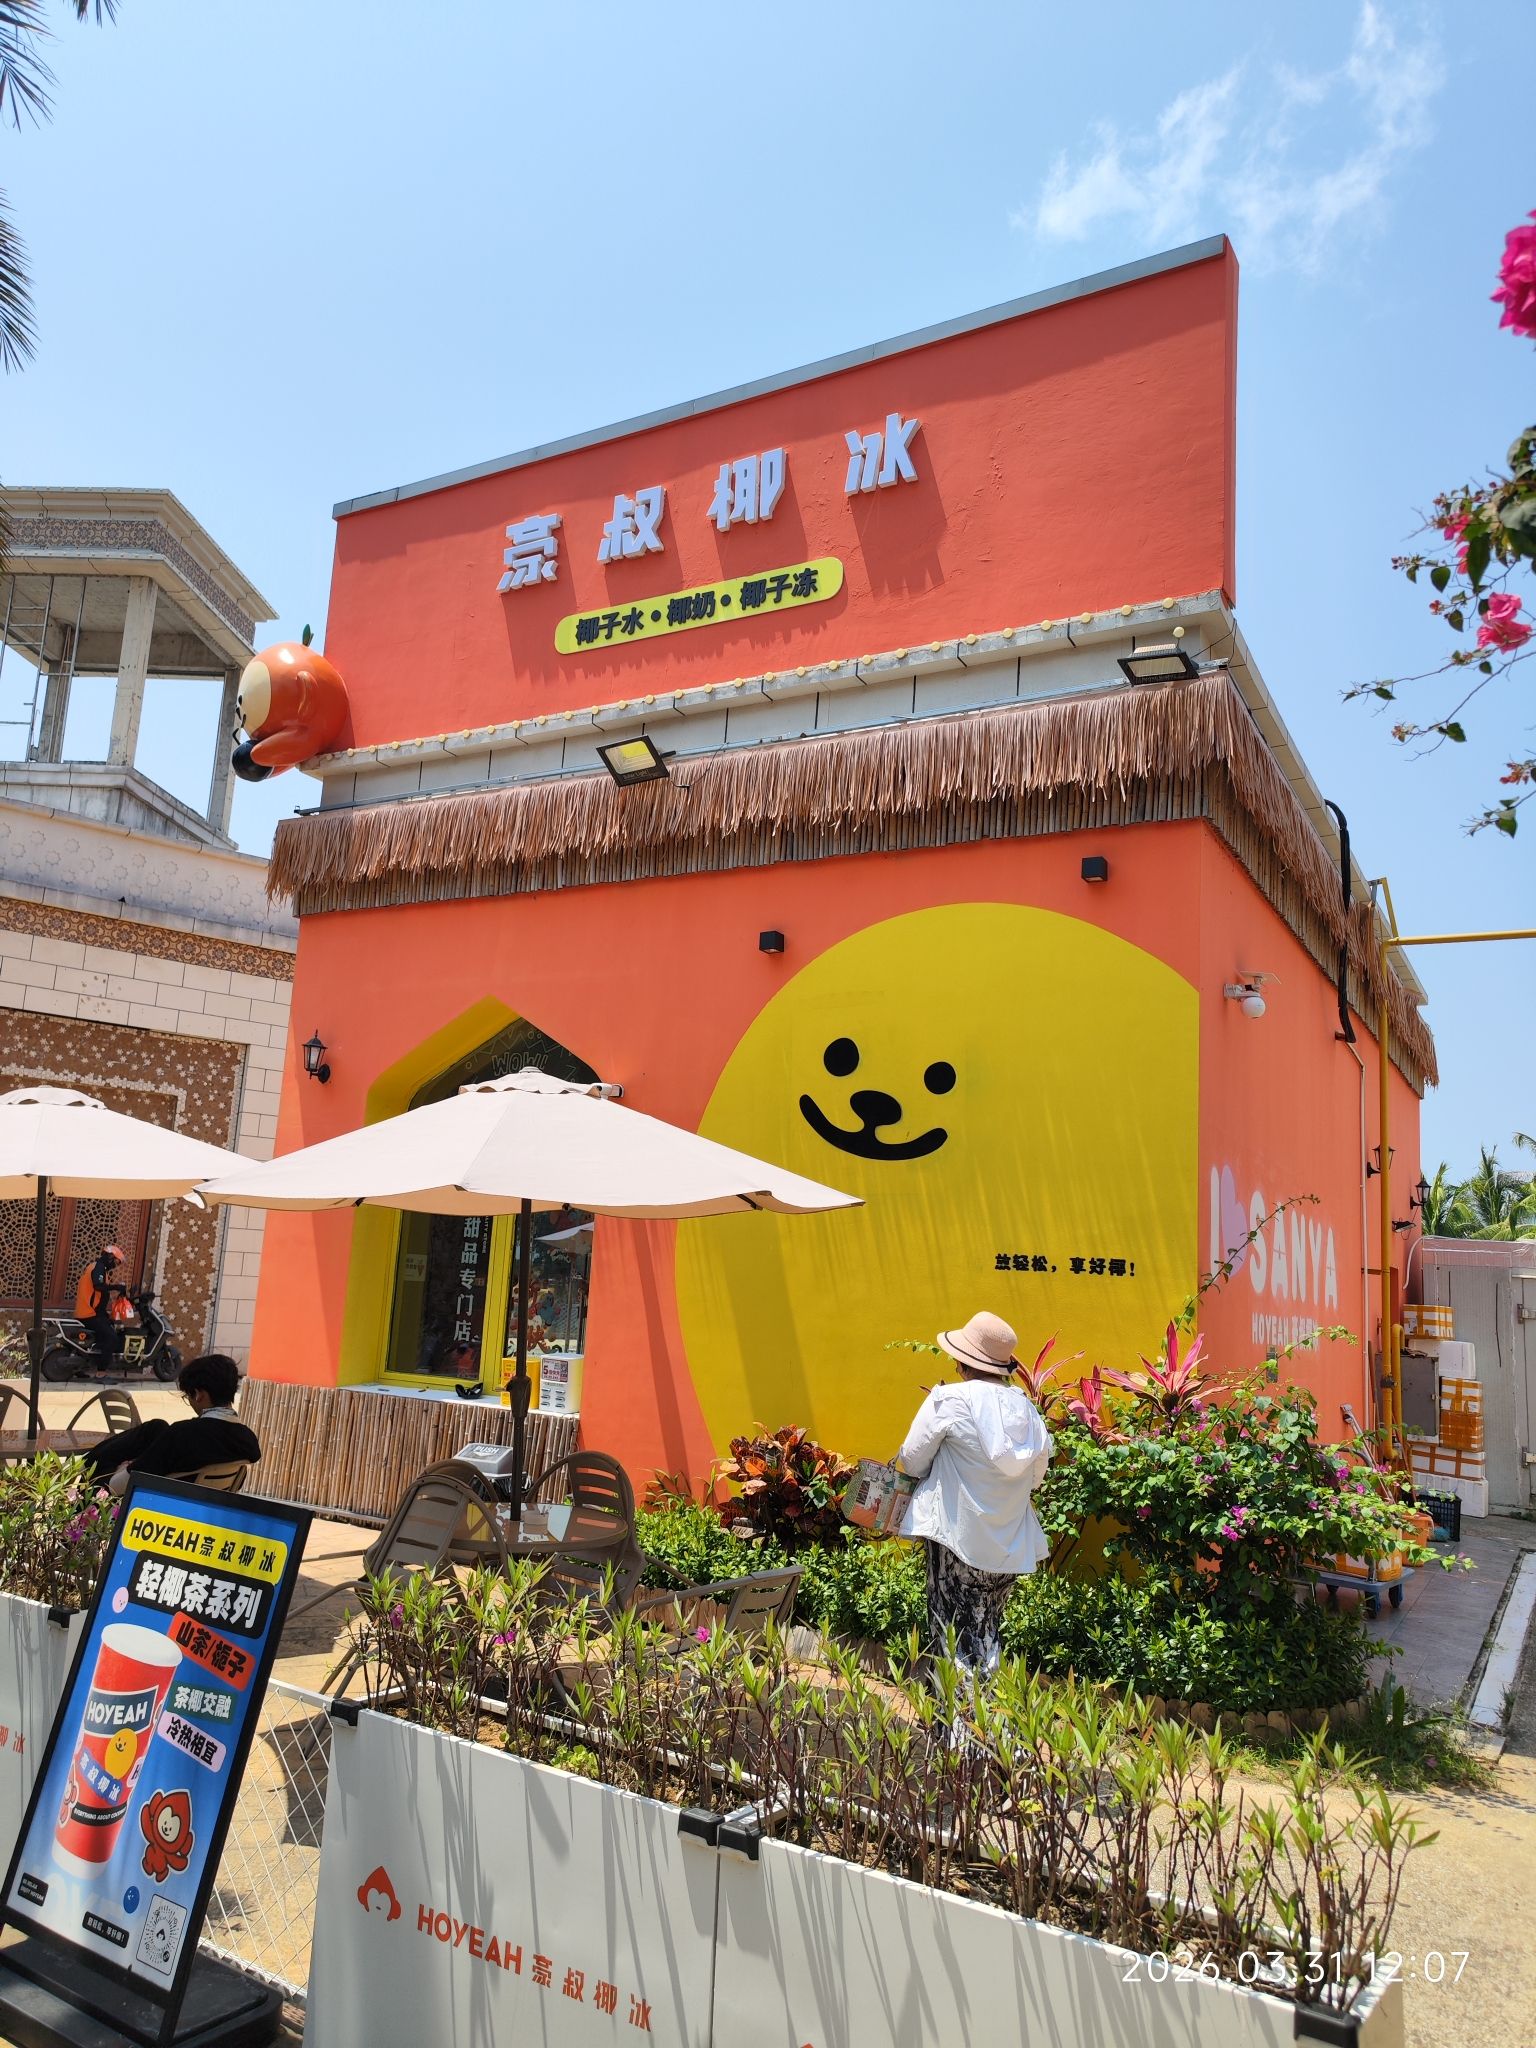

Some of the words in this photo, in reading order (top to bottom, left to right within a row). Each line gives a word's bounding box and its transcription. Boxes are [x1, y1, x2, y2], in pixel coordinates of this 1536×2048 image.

[496, 411, 922, 593] 豪叔椰冰
[453, 1216, 482, 1342] 甜品专门店
[1249, 1190, 1339, 1311] SANYA
[1252, 1312, 1290, 1347] HOYEAH
[473, 1445, 499, 1454] PUSH
[130, 1518, 201, 1553] HOYEAH
[199, 1536, 277, 1573] 豪叔椰冰
[135, 1559, 263, 1629] 轻椰茶系列
[176, 1619, 249, 1678] 山茶/栀子
[87, 1700, 149, 1725] HOYEAH
[173, 1686, 234, 1719] 茶椰交融
[166, 1716, 219, 1766] 冷热相宜
[417, 1903, 523, 1976] HOYEAH
[531, 1952, 653, 2033] 豪叔椰冰
